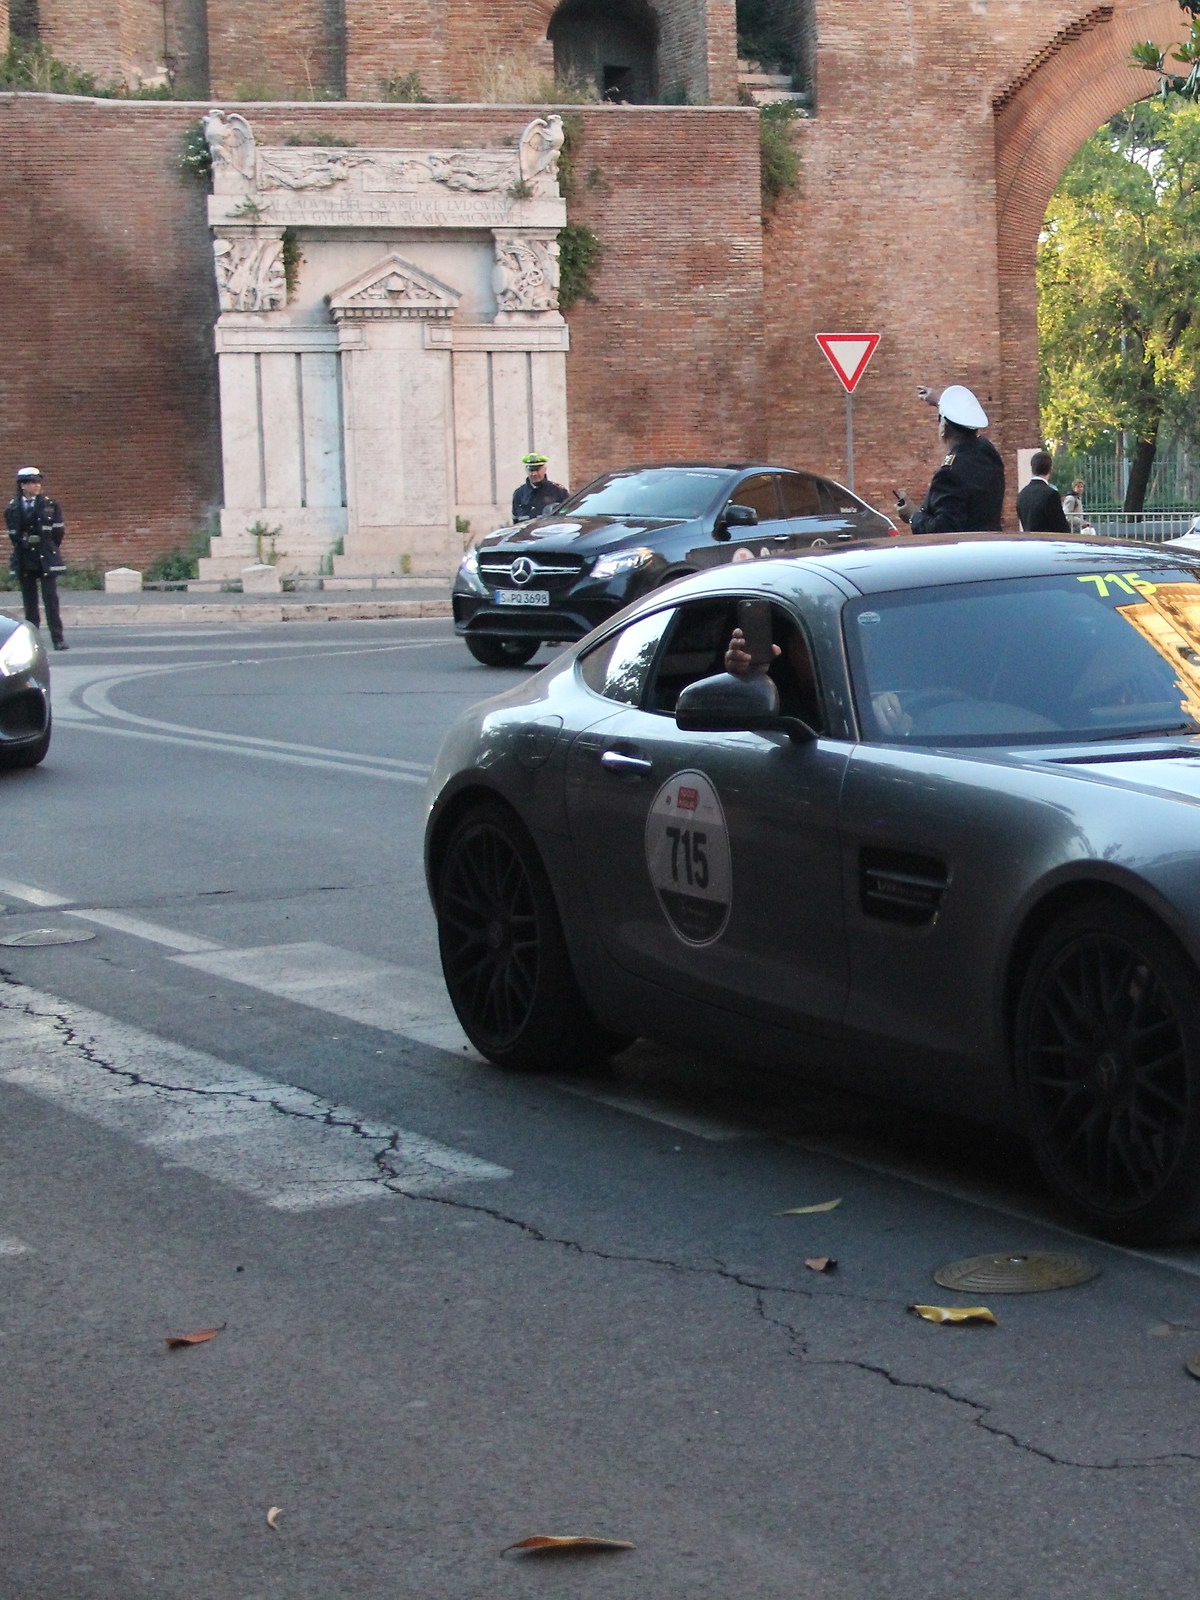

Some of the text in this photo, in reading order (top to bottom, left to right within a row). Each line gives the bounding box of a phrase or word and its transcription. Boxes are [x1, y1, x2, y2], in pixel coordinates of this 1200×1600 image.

[1076, 572, 1157, 597] 715
[511, 593, 522, 604] PQ
[524, 593, 548, 604] 3698
[666, 826, 709, 889] 715
